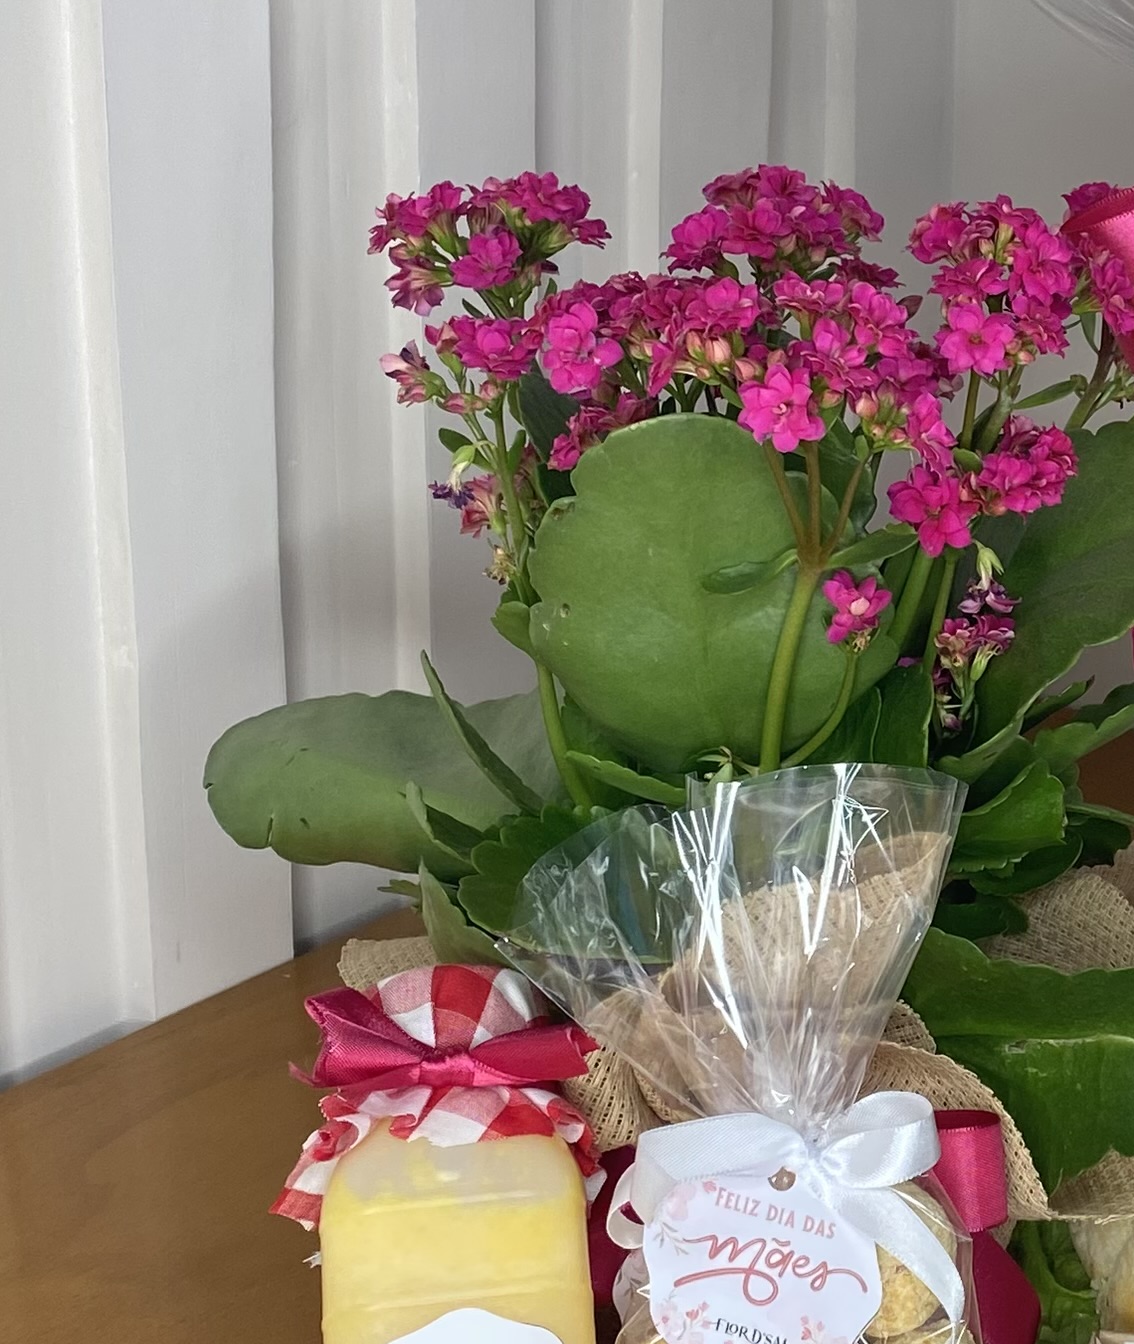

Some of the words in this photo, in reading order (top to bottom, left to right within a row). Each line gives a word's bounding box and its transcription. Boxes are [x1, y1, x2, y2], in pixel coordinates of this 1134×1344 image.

[714, 1188, 762, 1218] FELIZ
[766, 1203, 796, 1229] DIA
[803, 1214, 837, 1240] DAS
[674, 1233, 869, 1306] mães
